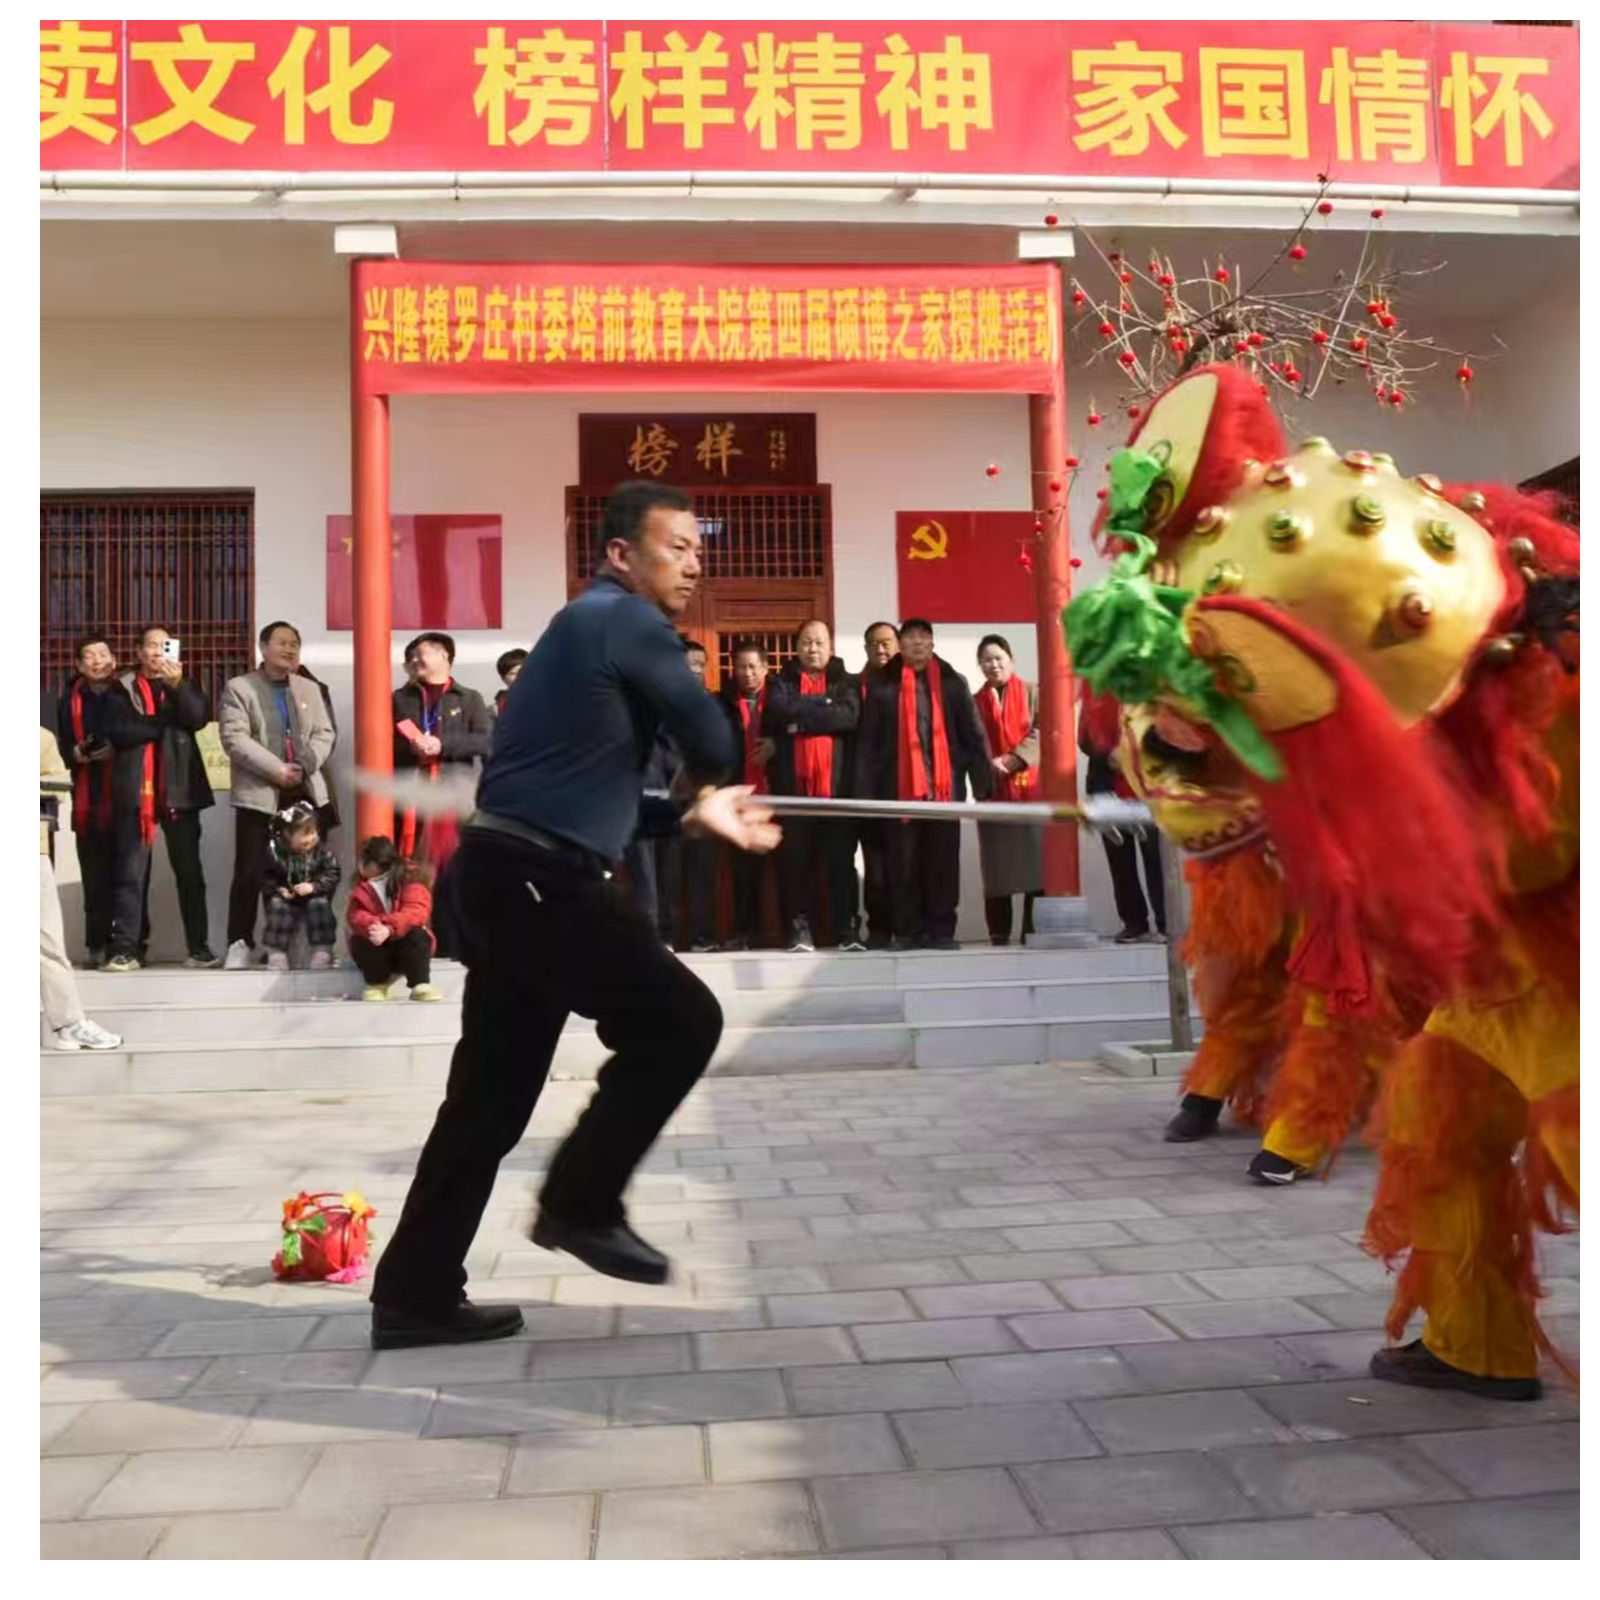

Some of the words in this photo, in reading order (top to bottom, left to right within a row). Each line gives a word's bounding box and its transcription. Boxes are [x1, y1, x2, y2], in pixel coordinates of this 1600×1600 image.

[473, 28, 993, 150] 榜样精神
[1072, 40, 1554, 167] 家国情怀
[628, 421, 743, 476] 榜样
